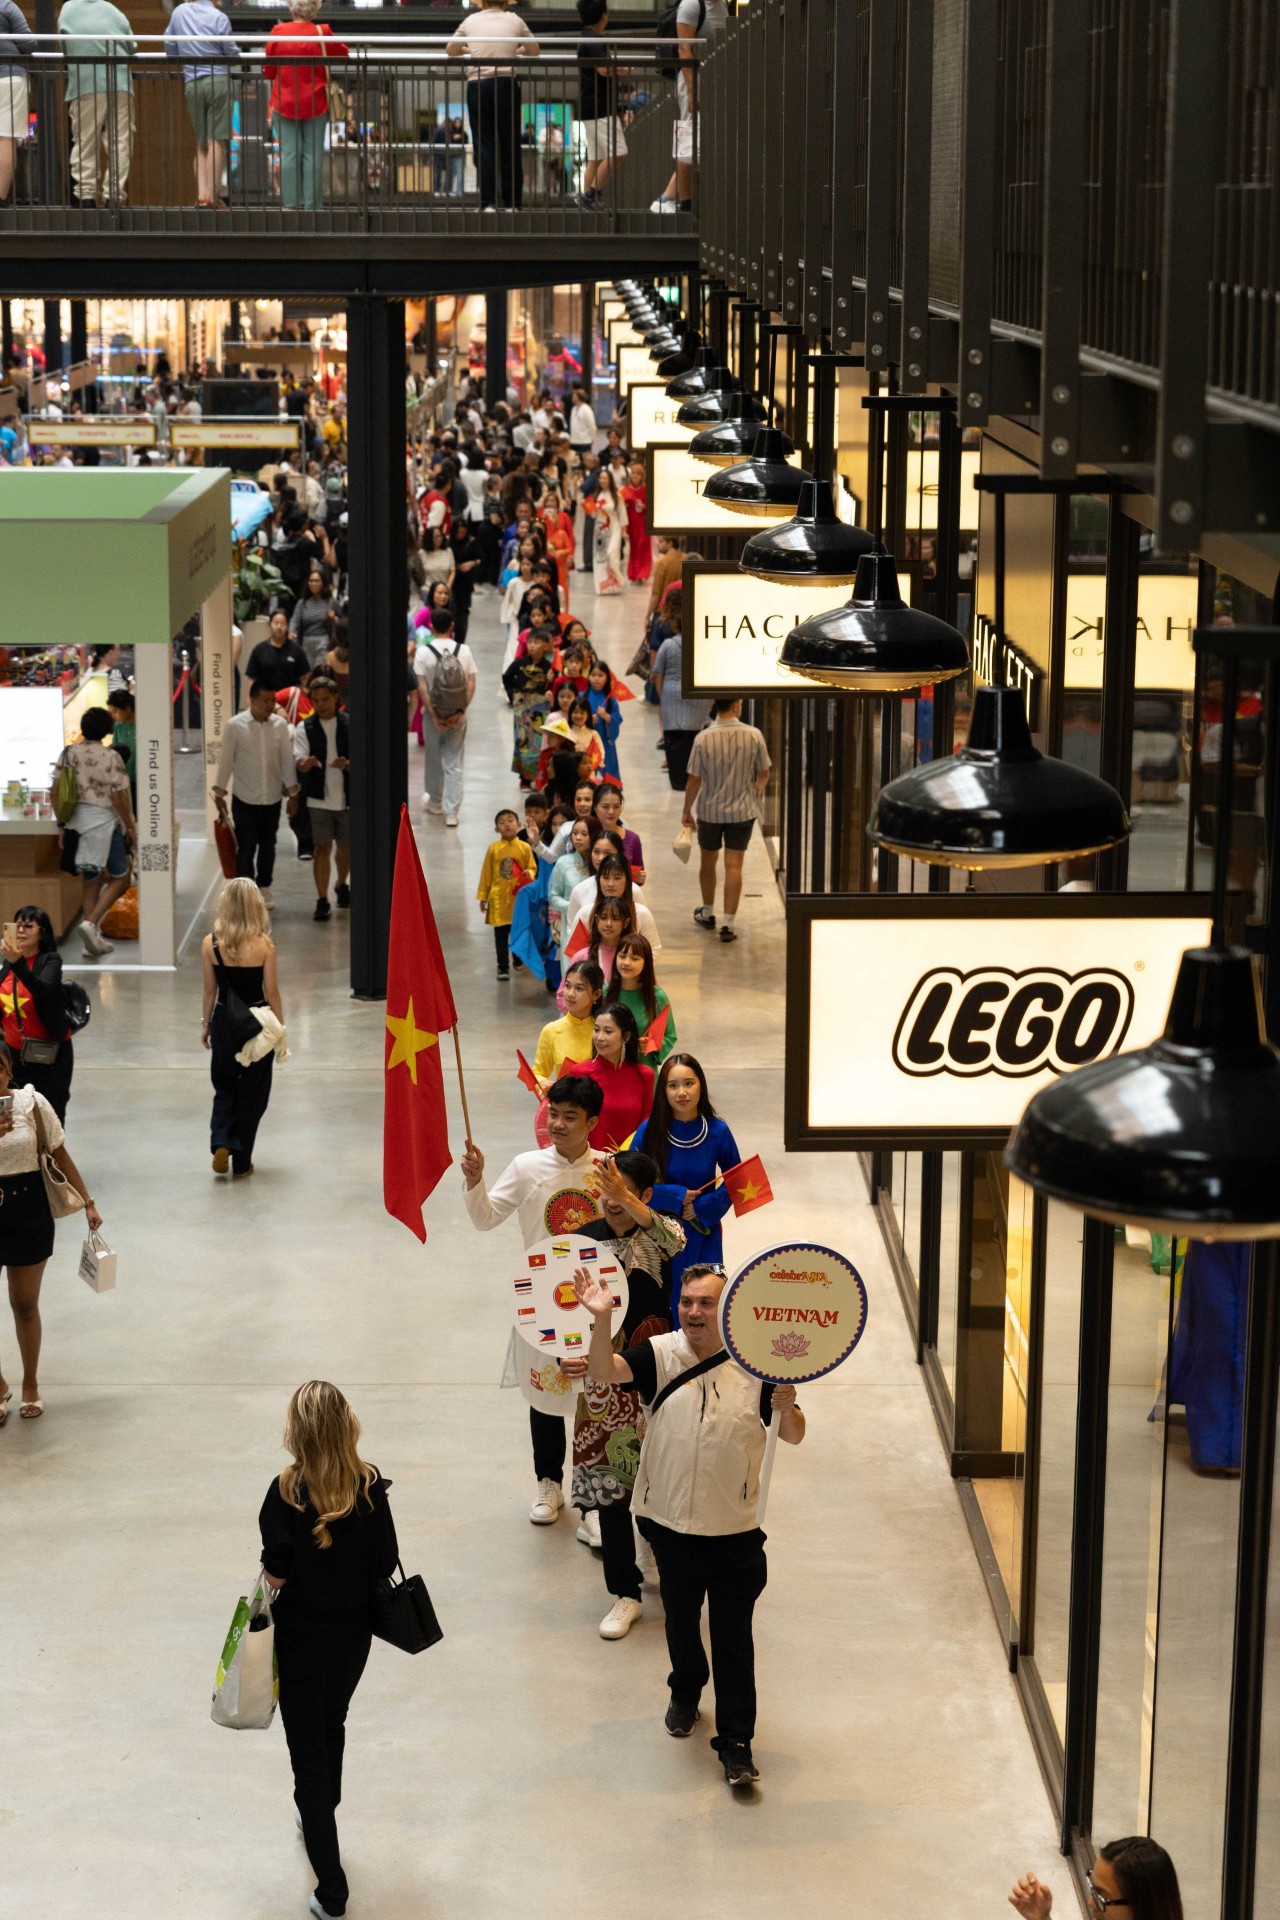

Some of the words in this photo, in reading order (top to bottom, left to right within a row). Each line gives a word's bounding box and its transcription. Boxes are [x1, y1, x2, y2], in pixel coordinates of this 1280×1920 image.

[212, 653, 222, 678] Find
[973, 614, 1034, 726] HACETT
[212, 681, 220, 696] us
[212, 698, 223, 736] Online
[148, 740, 159, 769] Find
[149, 773, 157, 789] us
[149, 793, 161, 838] Online
[904, 980, 1122, 1066] LEGO
[753, 1306, 839, 1328] VIETNAM
